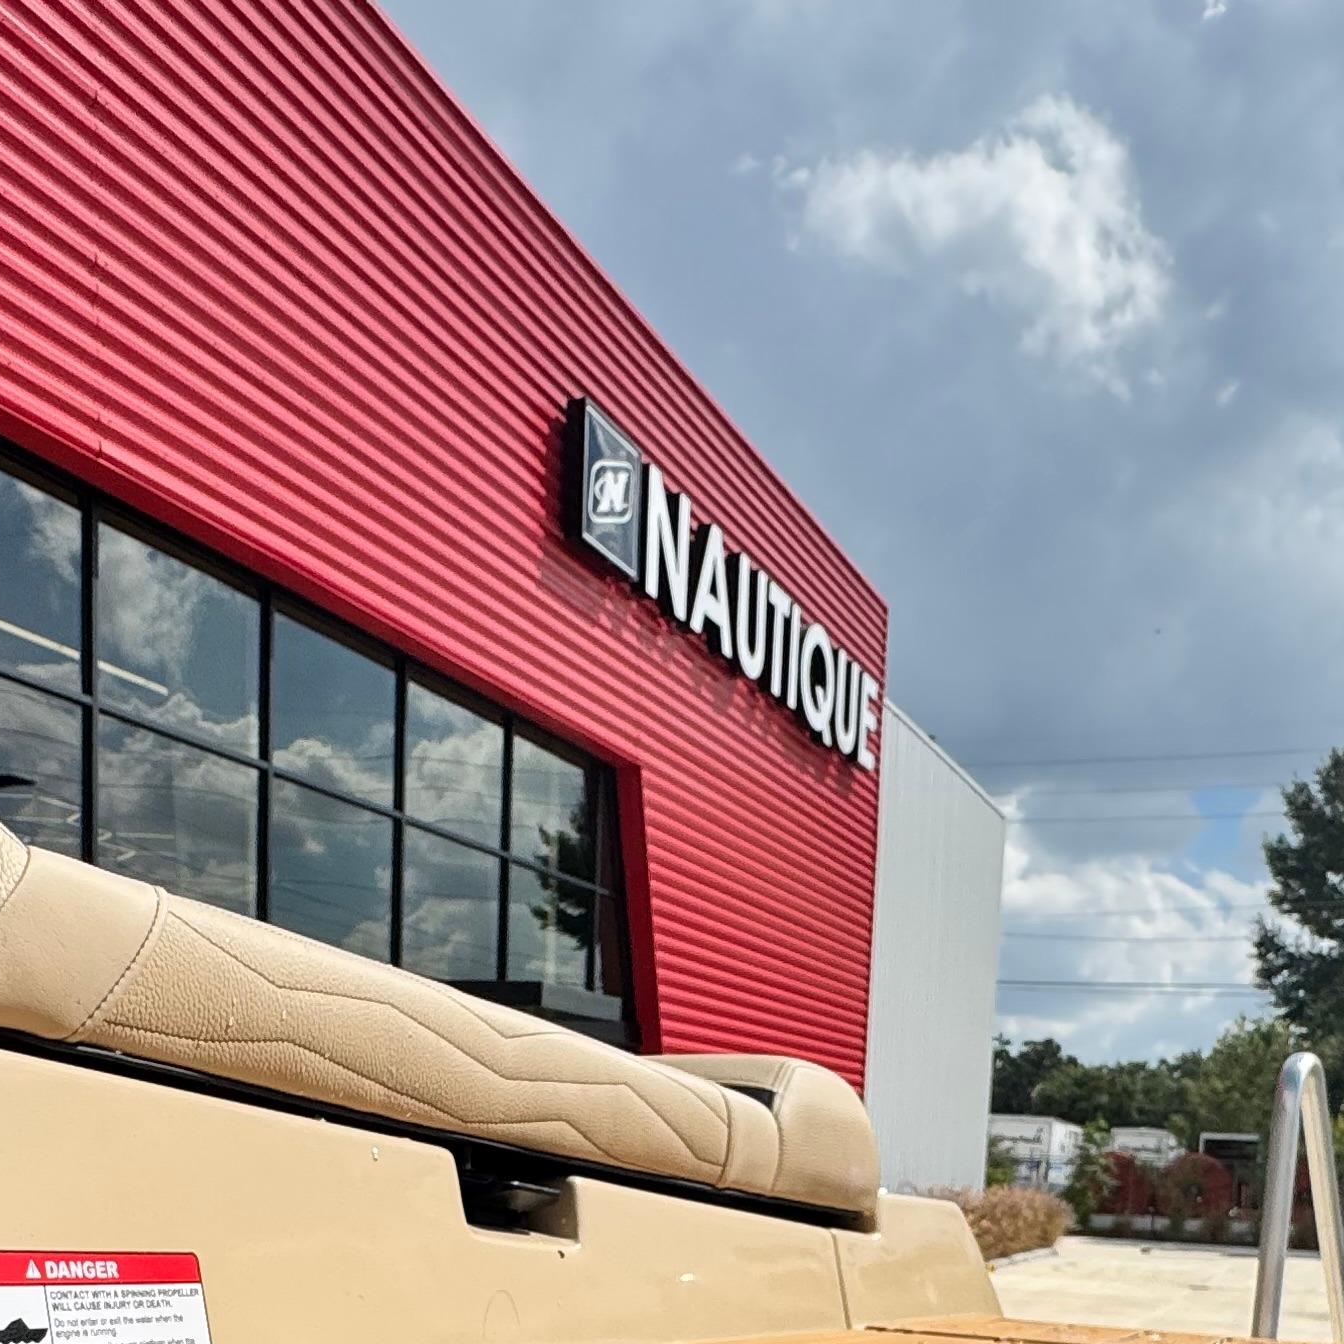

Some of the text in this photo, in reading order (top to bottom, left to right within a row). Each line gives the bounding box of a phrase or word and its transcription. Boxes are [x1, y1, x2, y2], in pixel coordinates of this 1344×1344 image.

[645, 463, 879, 771] NAUTIQUE
[44, 1261, 119, 1279] DANGER
[49, 1290, 89, 1300] CONTACT
[112, 1289, 118, 1298] A
[51, 1302, 72, 1311] WILL
[73, 1301, 101, 1310] CAUSE
[132, 1300, 144, 1308] OR
